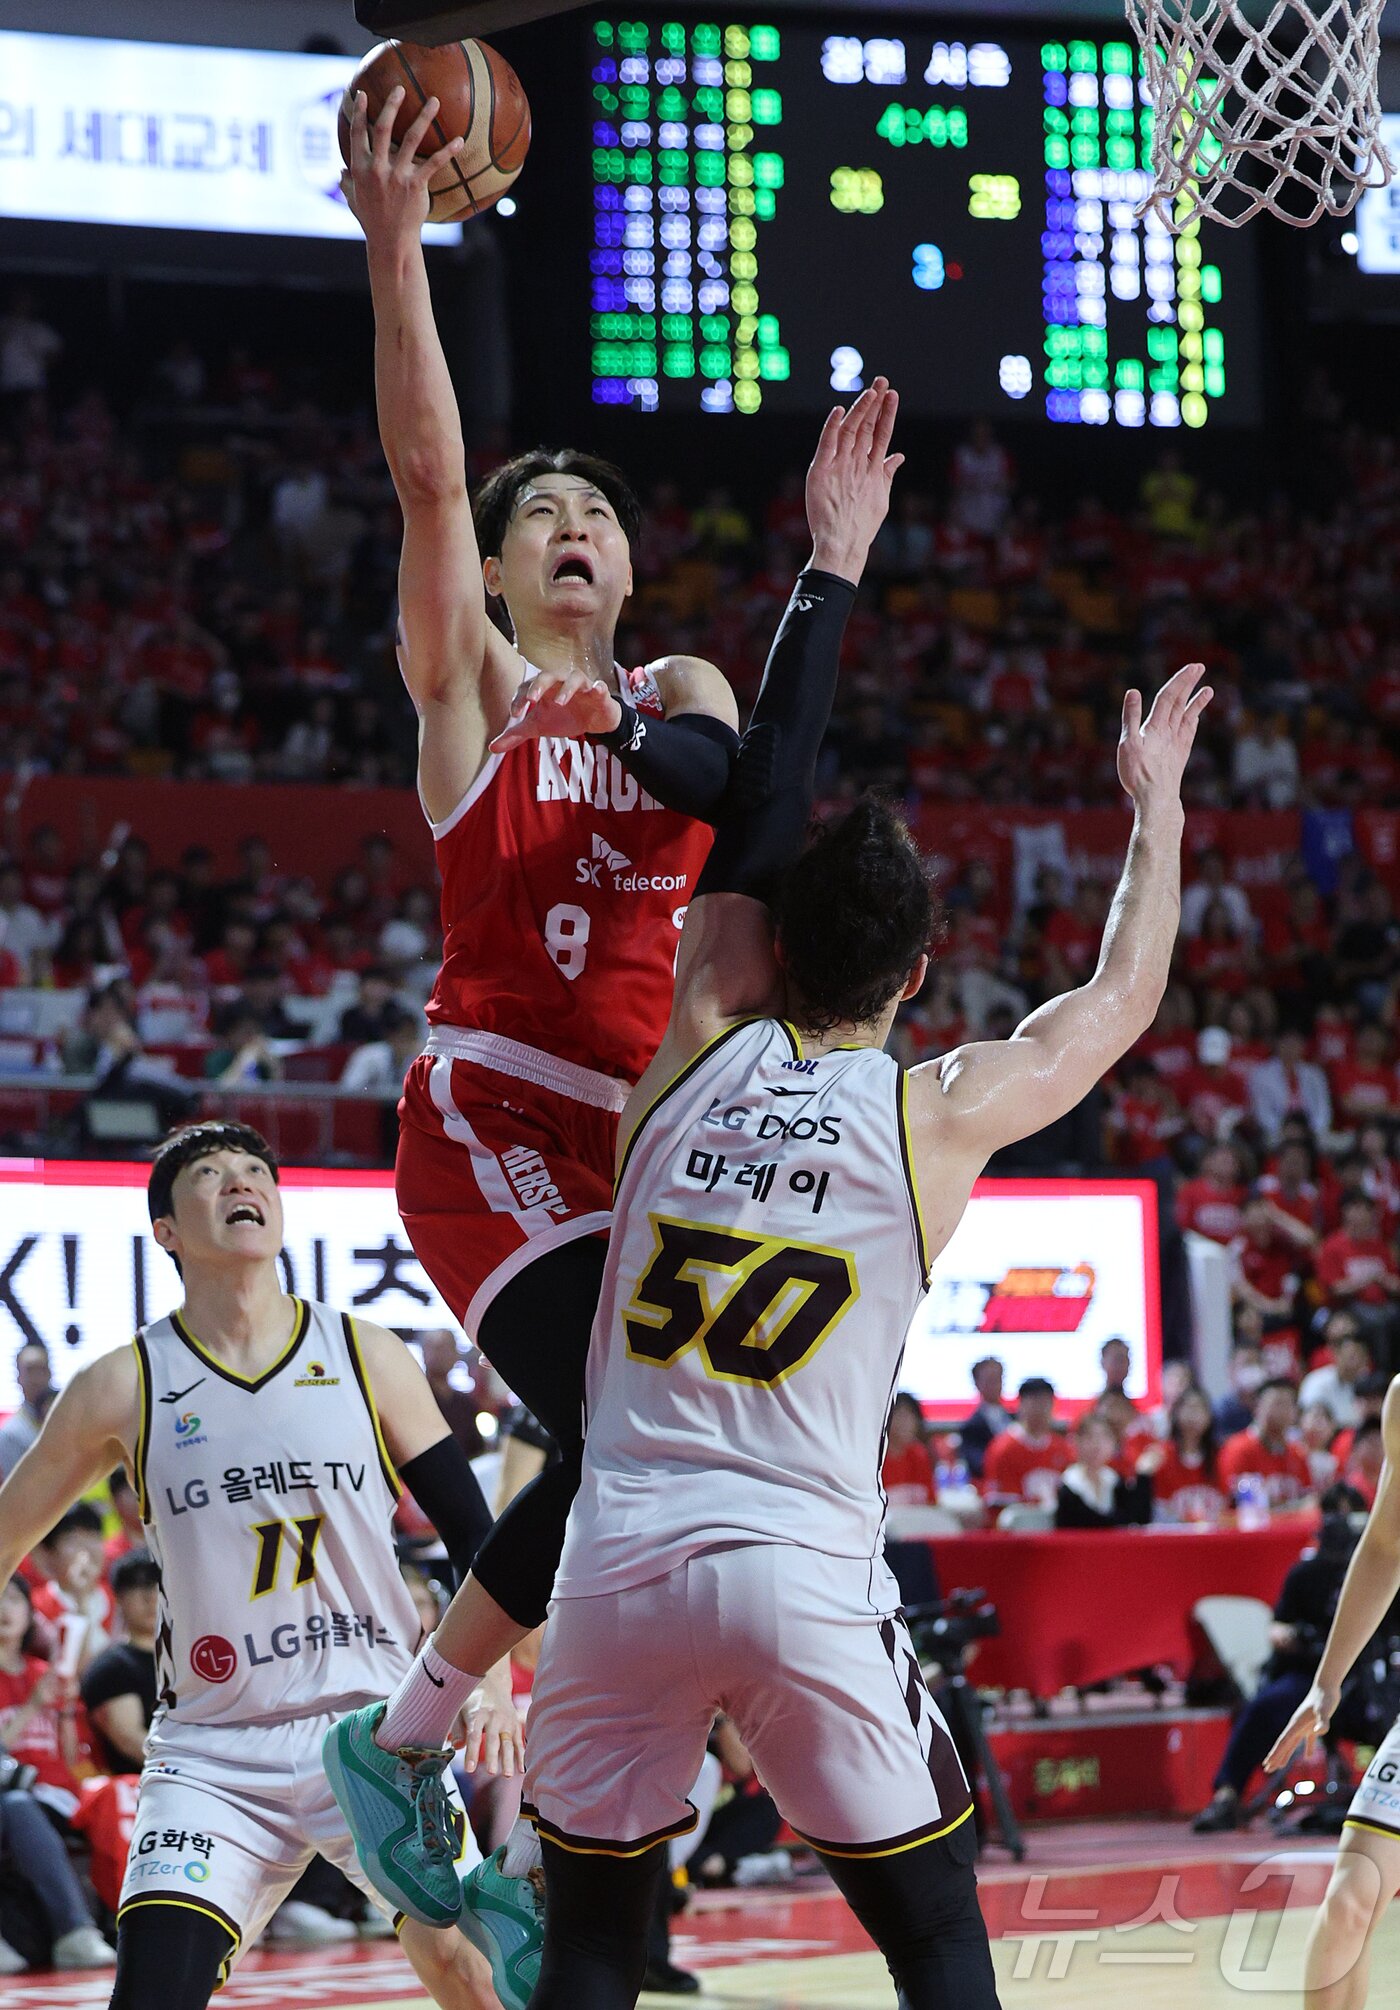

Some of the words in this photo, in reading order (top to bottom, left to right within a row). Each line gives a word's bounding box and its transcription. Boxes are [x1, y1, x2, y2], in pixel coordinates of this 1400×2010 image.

[576, 858, 602, 888] SK
[613, 872, 687, 892] telecom
[544, 902, 591, 981] 8
[701, 1098, 750, 1131] LG
[621, 1212, 861, 1391] 50
[166, 1479, 210, 1516] LG
[220, 1462, 319, 1503] 올레드
[324, 1463, 365, 1491] TV
[249, 1513, 325, 1602] 11
